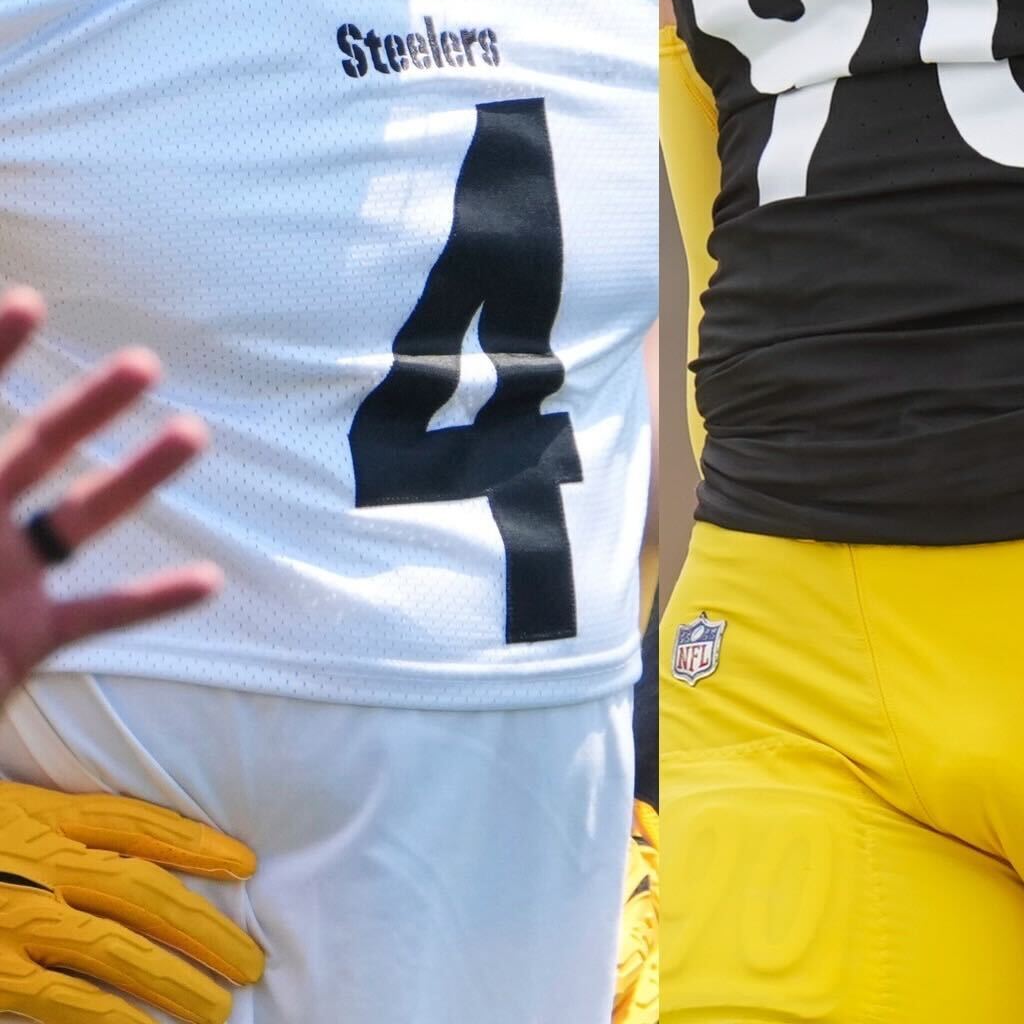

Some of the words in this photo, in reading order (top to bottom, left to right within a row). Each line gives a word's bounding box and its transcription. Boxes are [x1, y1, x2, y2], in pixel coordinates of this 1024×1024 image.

[336, 15, 501, 79] Steelers
[348, 97, 584, 644] 4
[677, 644, 709, 673] NFL
